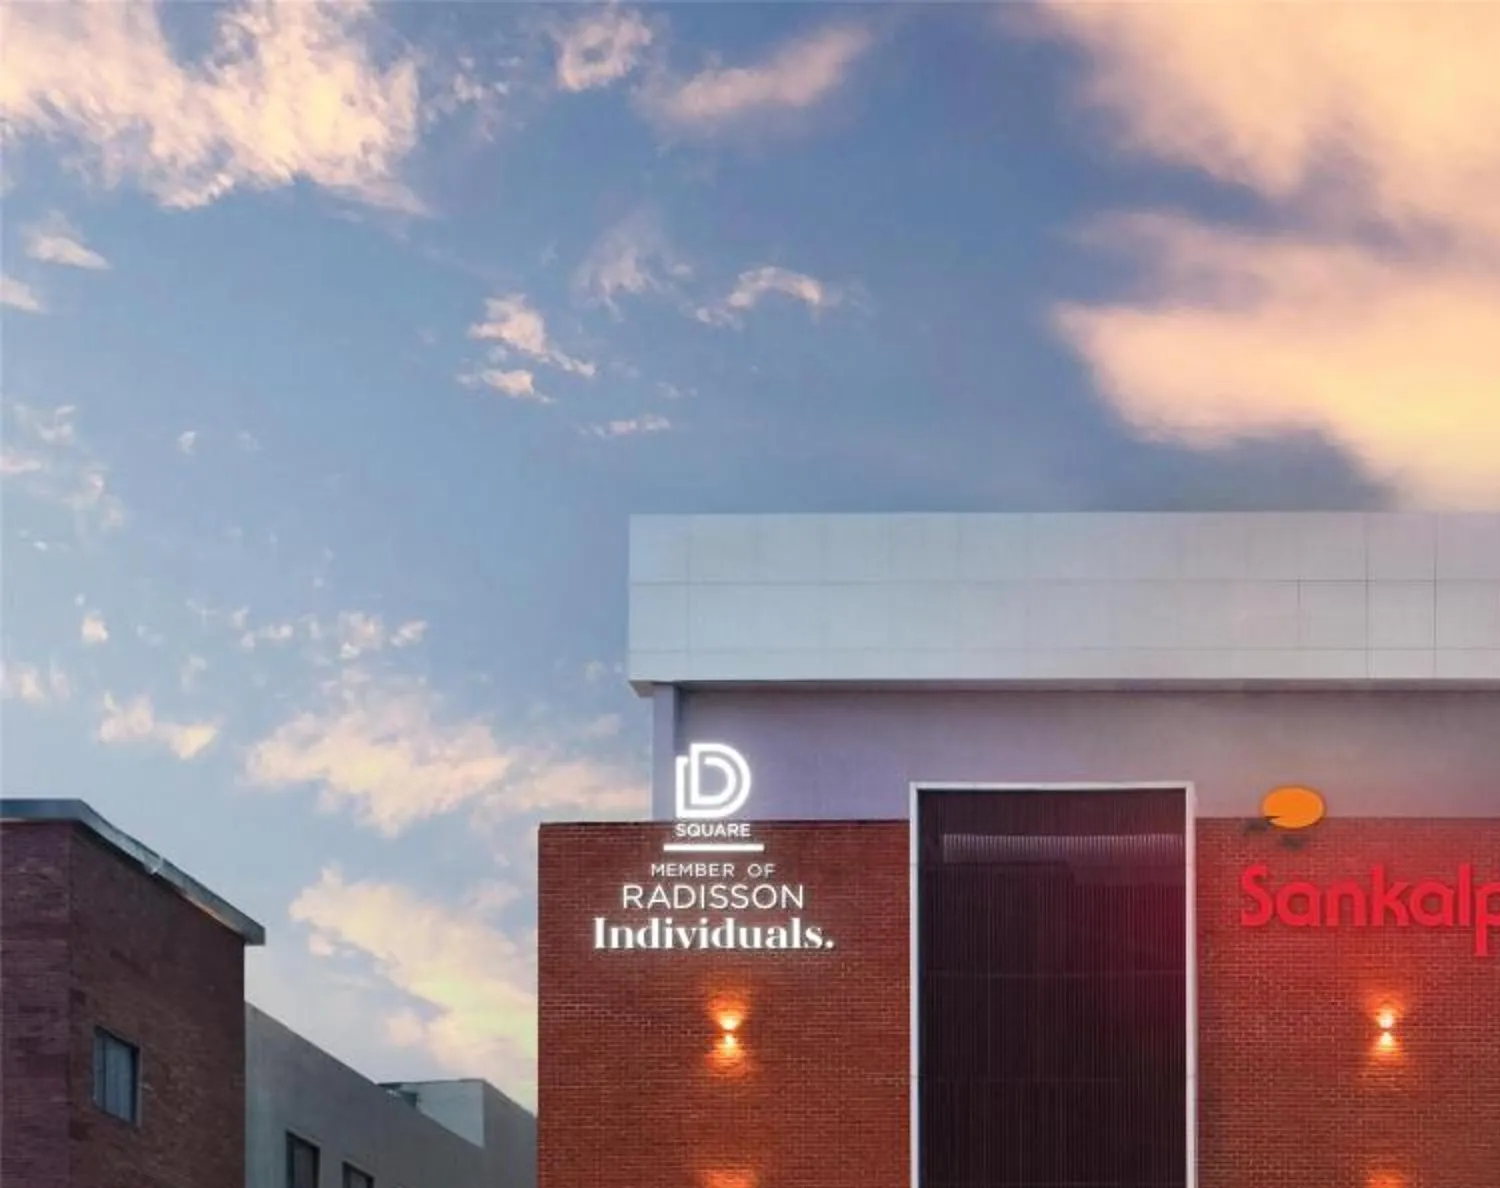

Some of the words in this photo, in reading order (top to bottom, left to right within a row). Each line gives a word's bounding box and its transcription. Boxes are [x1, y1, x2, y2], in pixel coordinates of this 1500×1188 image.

[674, 822, 752, 838] SQUARE
[650, 863, 735, 878] MEMBER
[747, 863, 776, 878] OF
[622, 884, 804, 910] RADISSON
[593, 917, 835, 950] Individuals.
